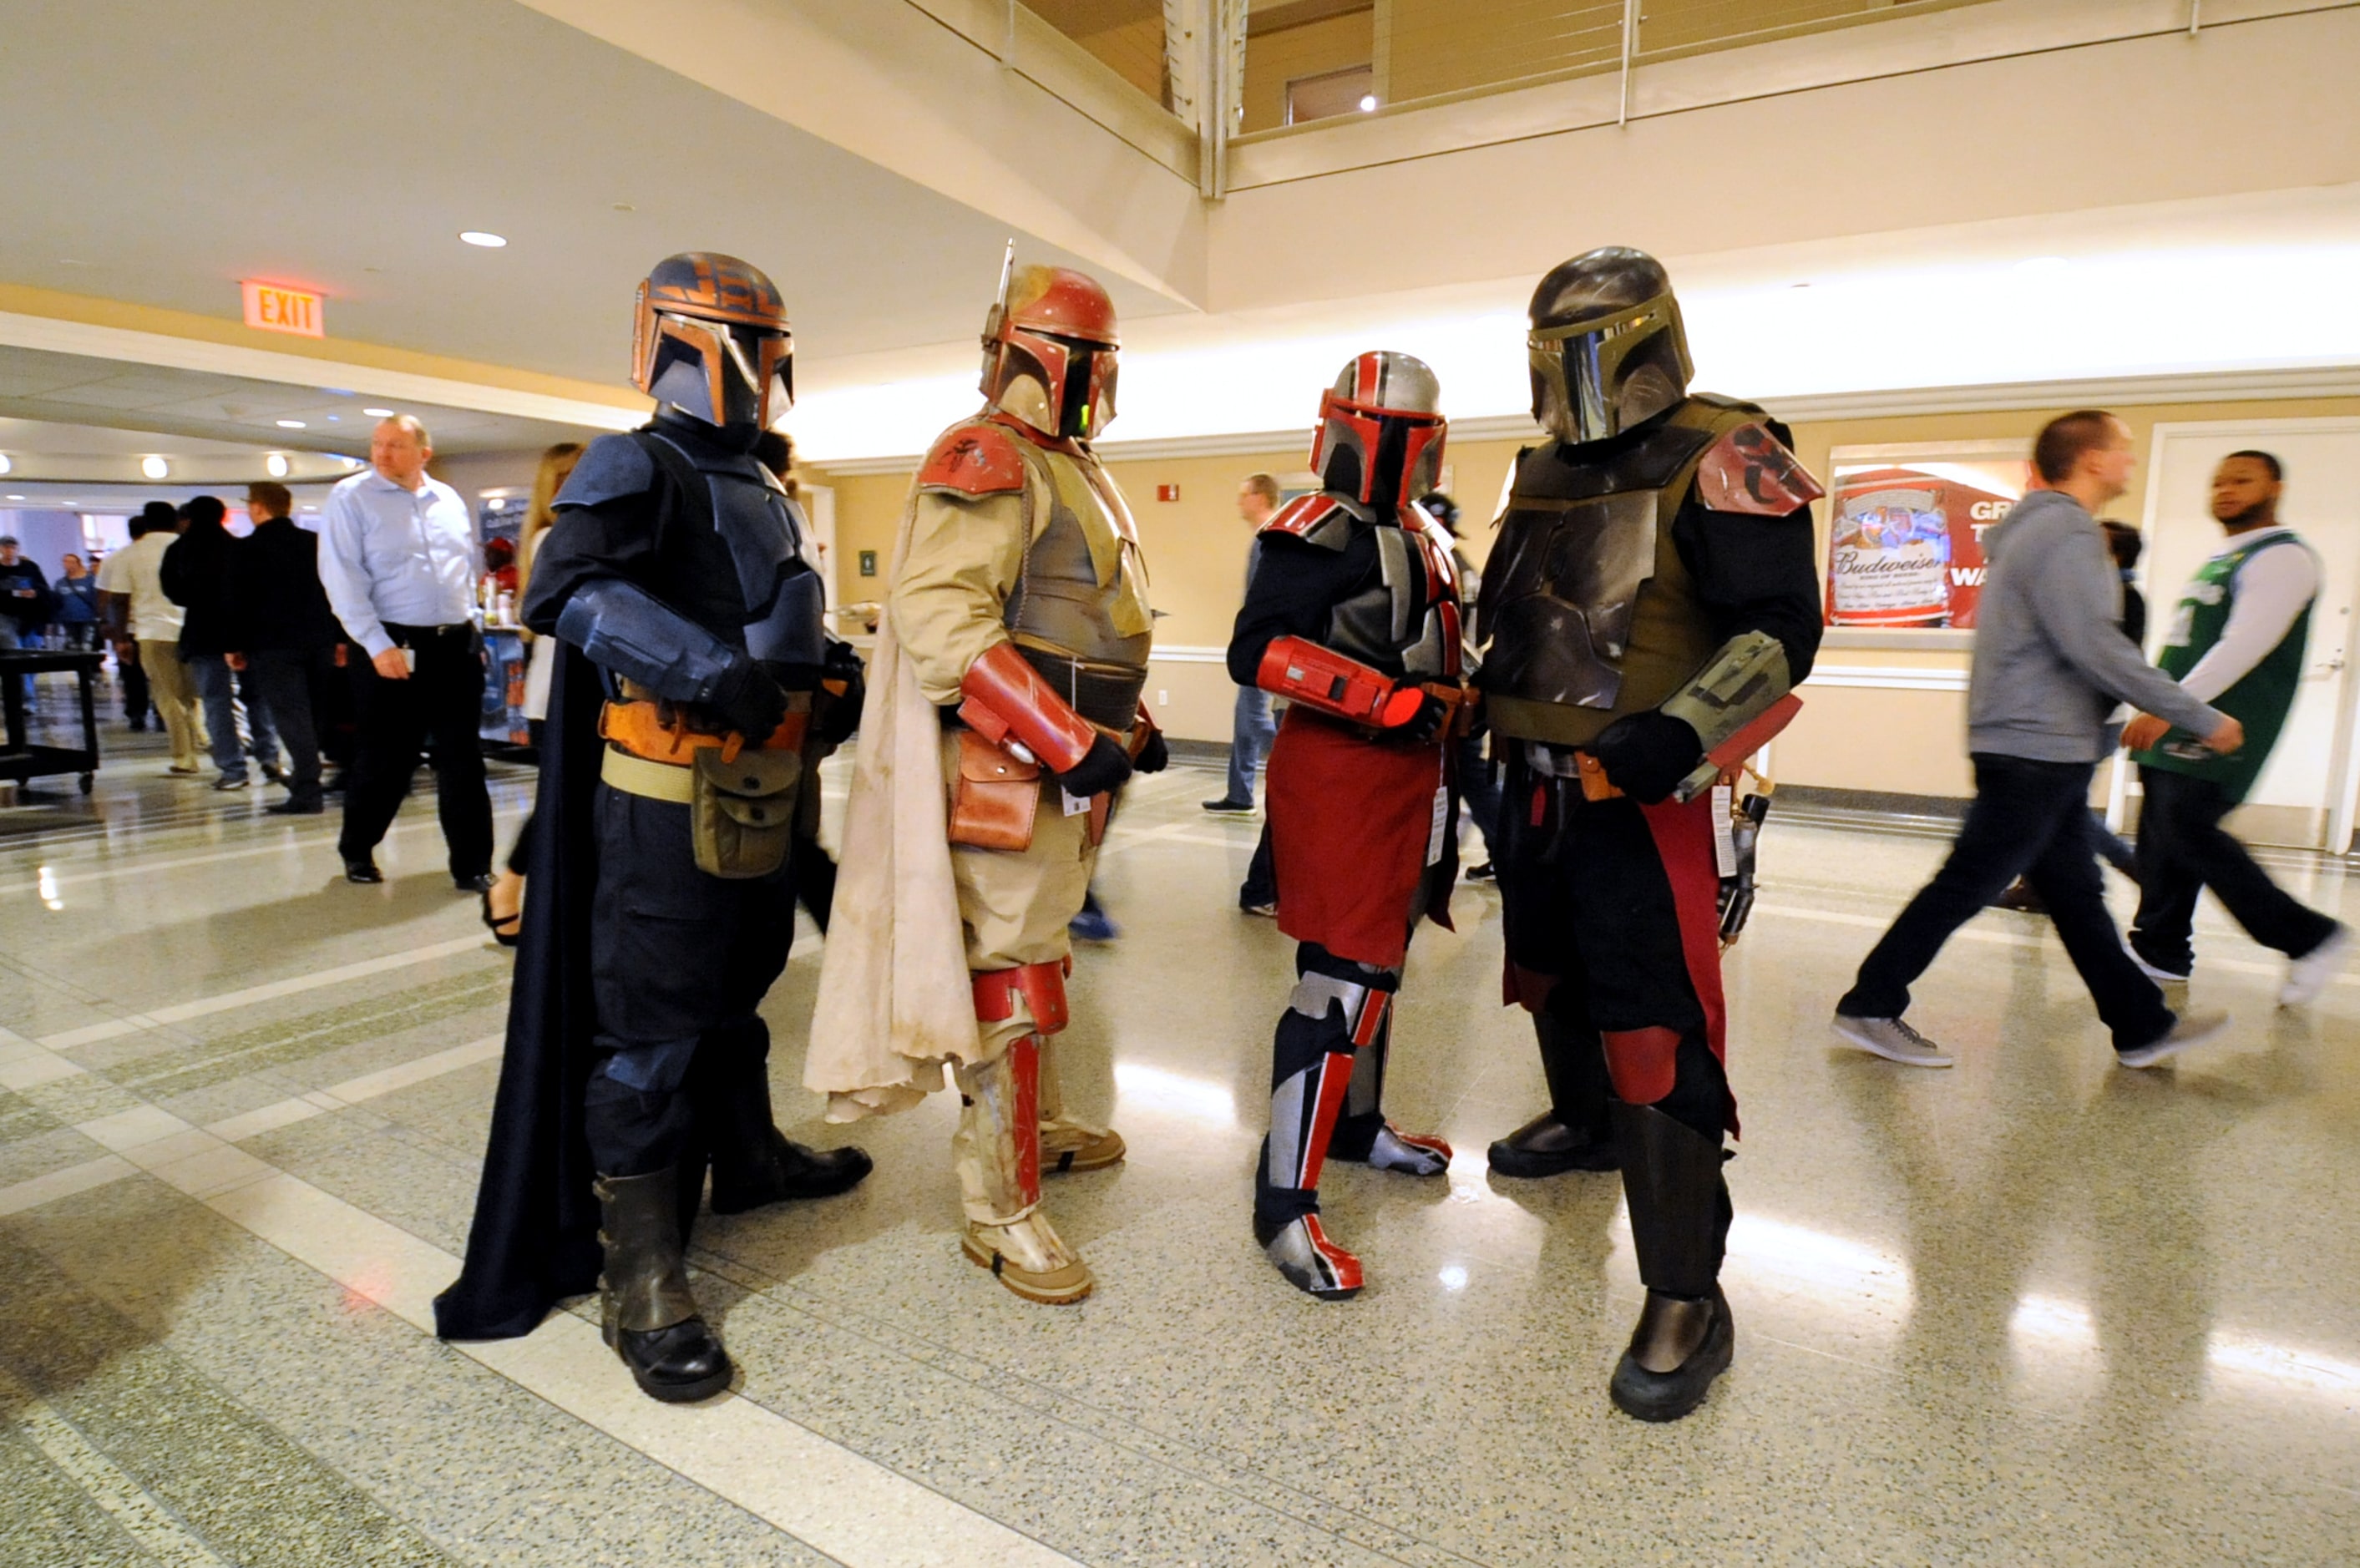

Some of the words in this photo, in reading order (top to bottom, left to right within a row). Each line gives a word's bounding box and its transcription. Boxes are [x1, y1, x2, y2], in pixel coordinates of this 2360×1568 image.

[258, 288, 314, 329] EXIT
[1970, 501, 2015, 520] GR
[1836, 551, 1940, 574] Budweiser
